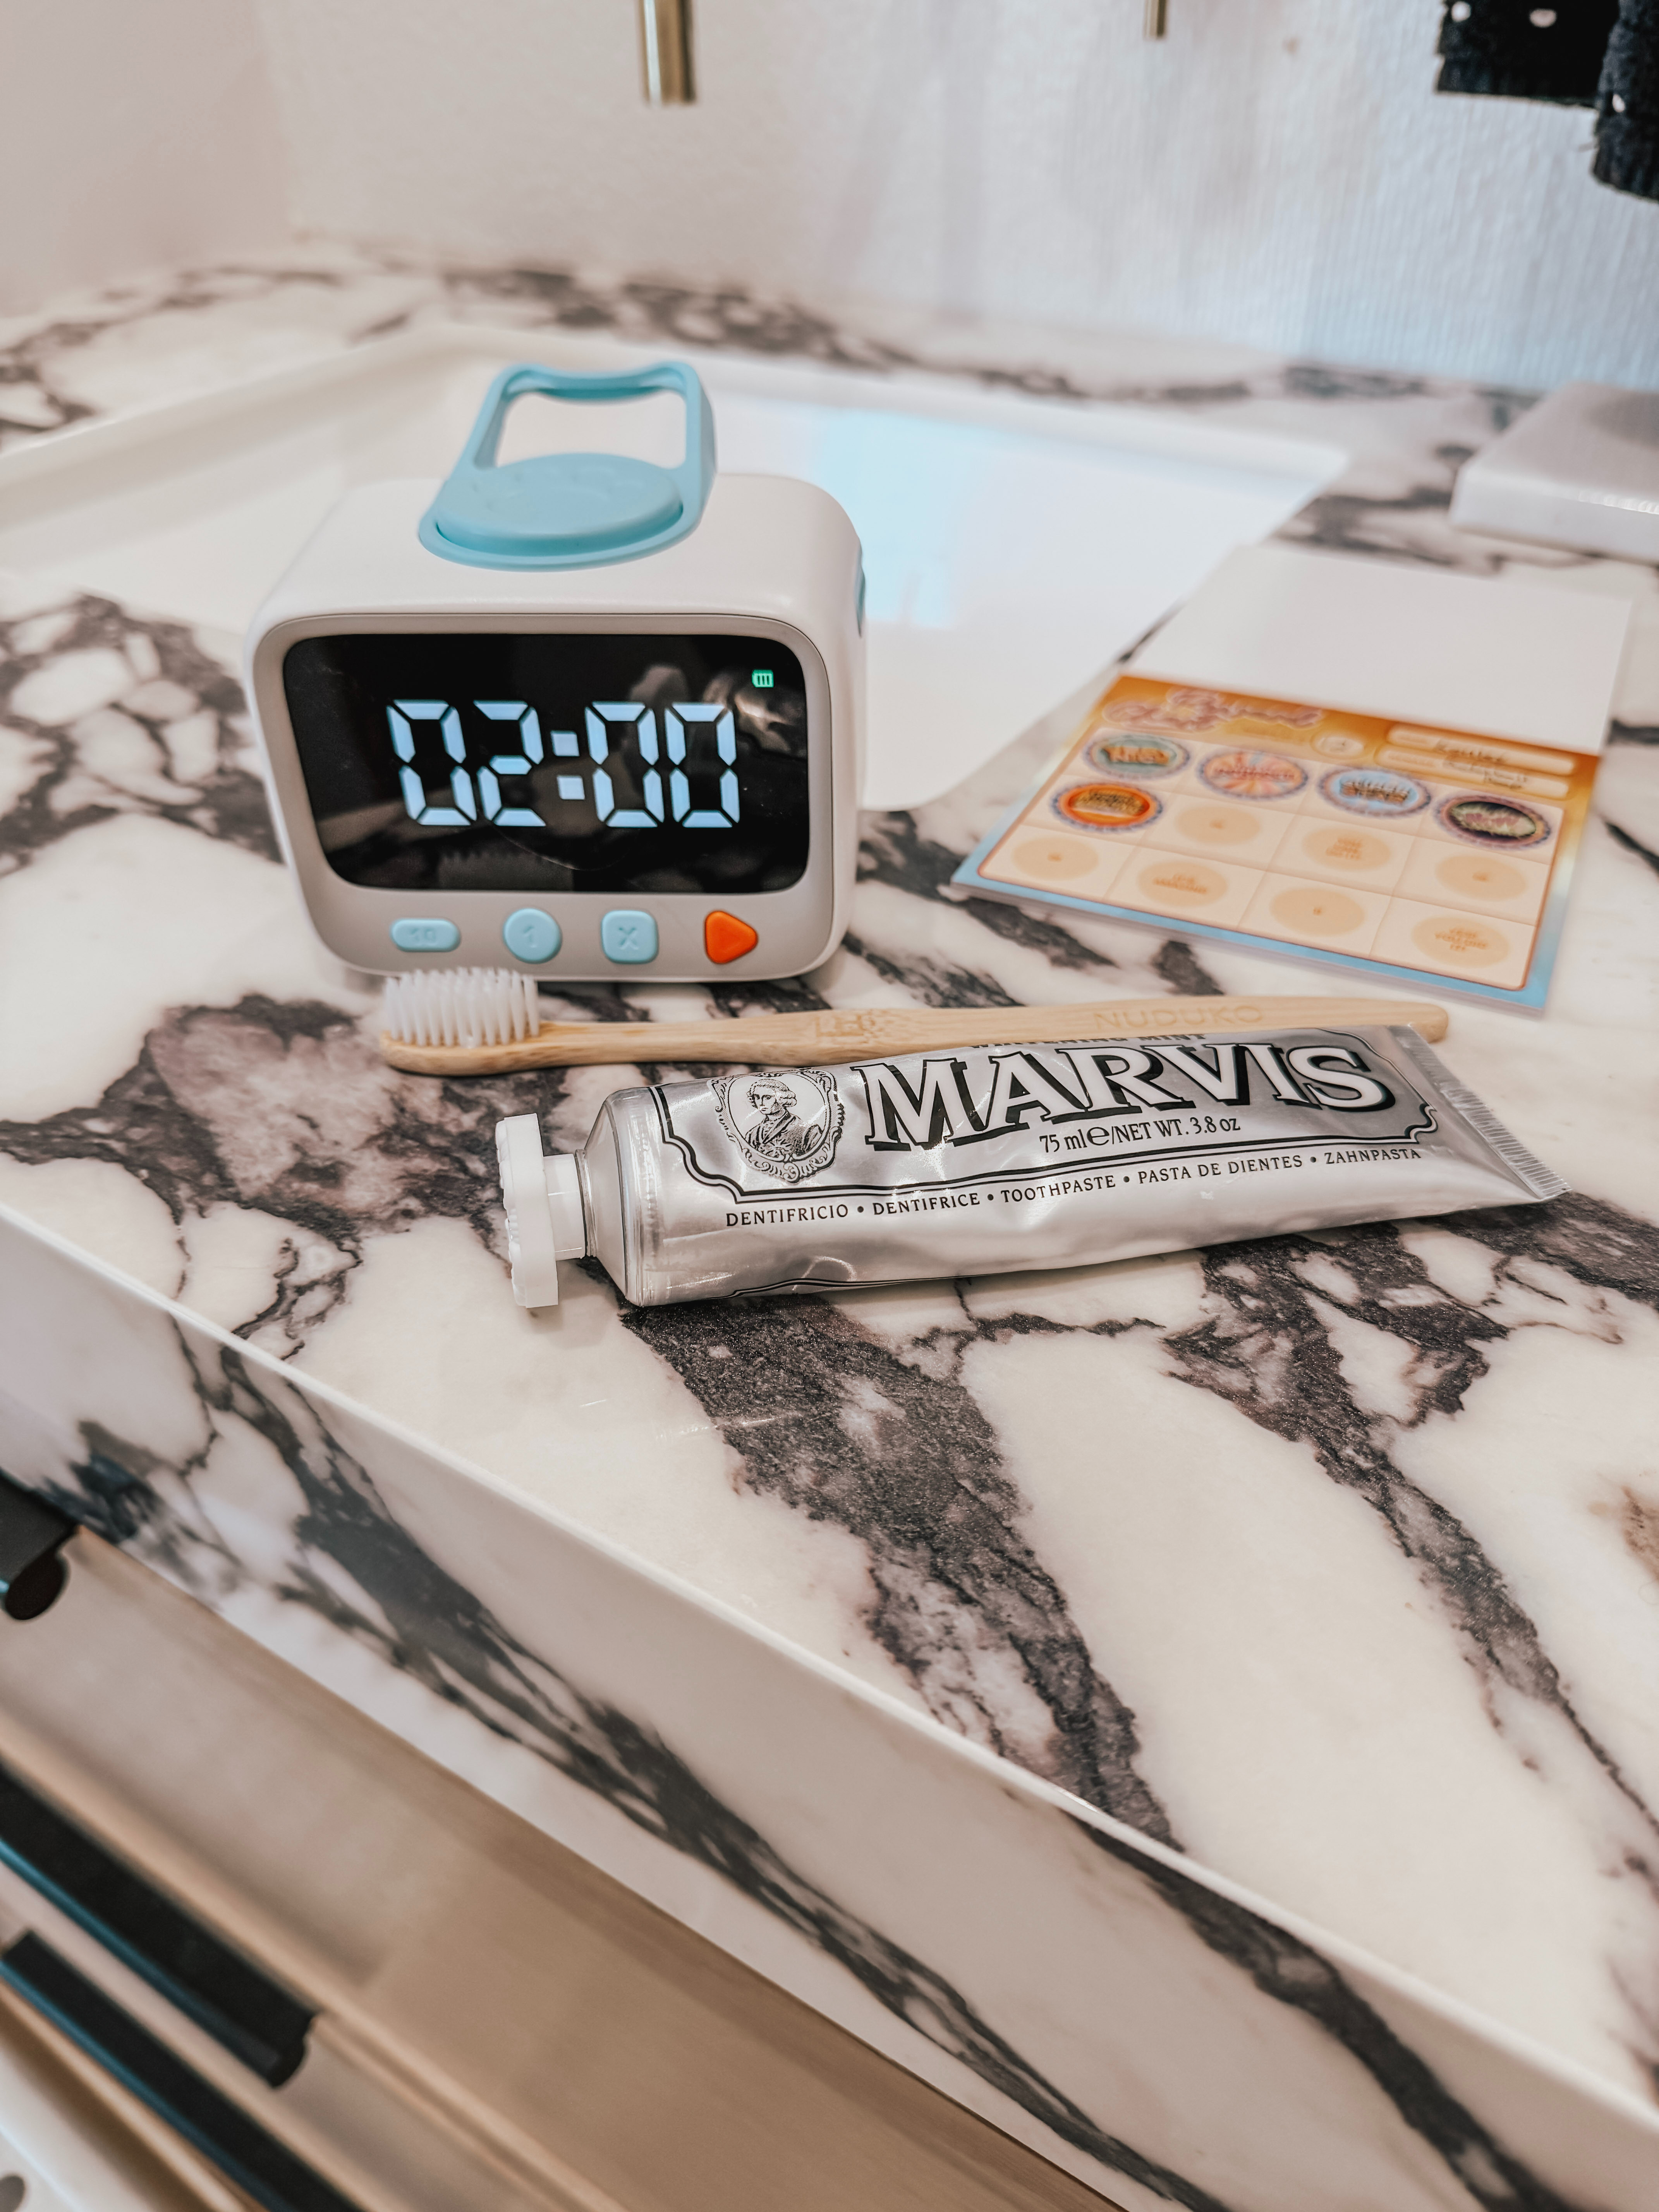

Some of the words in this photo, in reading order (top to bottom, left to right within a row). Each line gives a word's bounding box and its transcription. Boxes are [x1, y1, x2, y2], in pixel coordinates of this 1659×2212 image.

[386, 699, 740, 828] 02:00
[850, 1042, 1396, 1151] MARVIS
[1039, 1134, 1060, 1153] 75
[1152, 1118, 1189, 1137] WT.
[1189, 1116, 1217, 1134] 3.8
[1219, 1118, 1241, 1132] oz
[725, 1204, 848, 1227] DENTIFRICIO
[872, 1192, 981, 1215] DENTIFRICE
[1001, 1175, 1116, 1203] TOOTHPASTE
[1138, 1166, 1192, 1184] PASTA
[1198, 1163, 1222, 1177] DE
[1228, 1154, 1303, 1174] DIENTES
[1324, 1148, 1422, 1165] ZAHNPASTA
